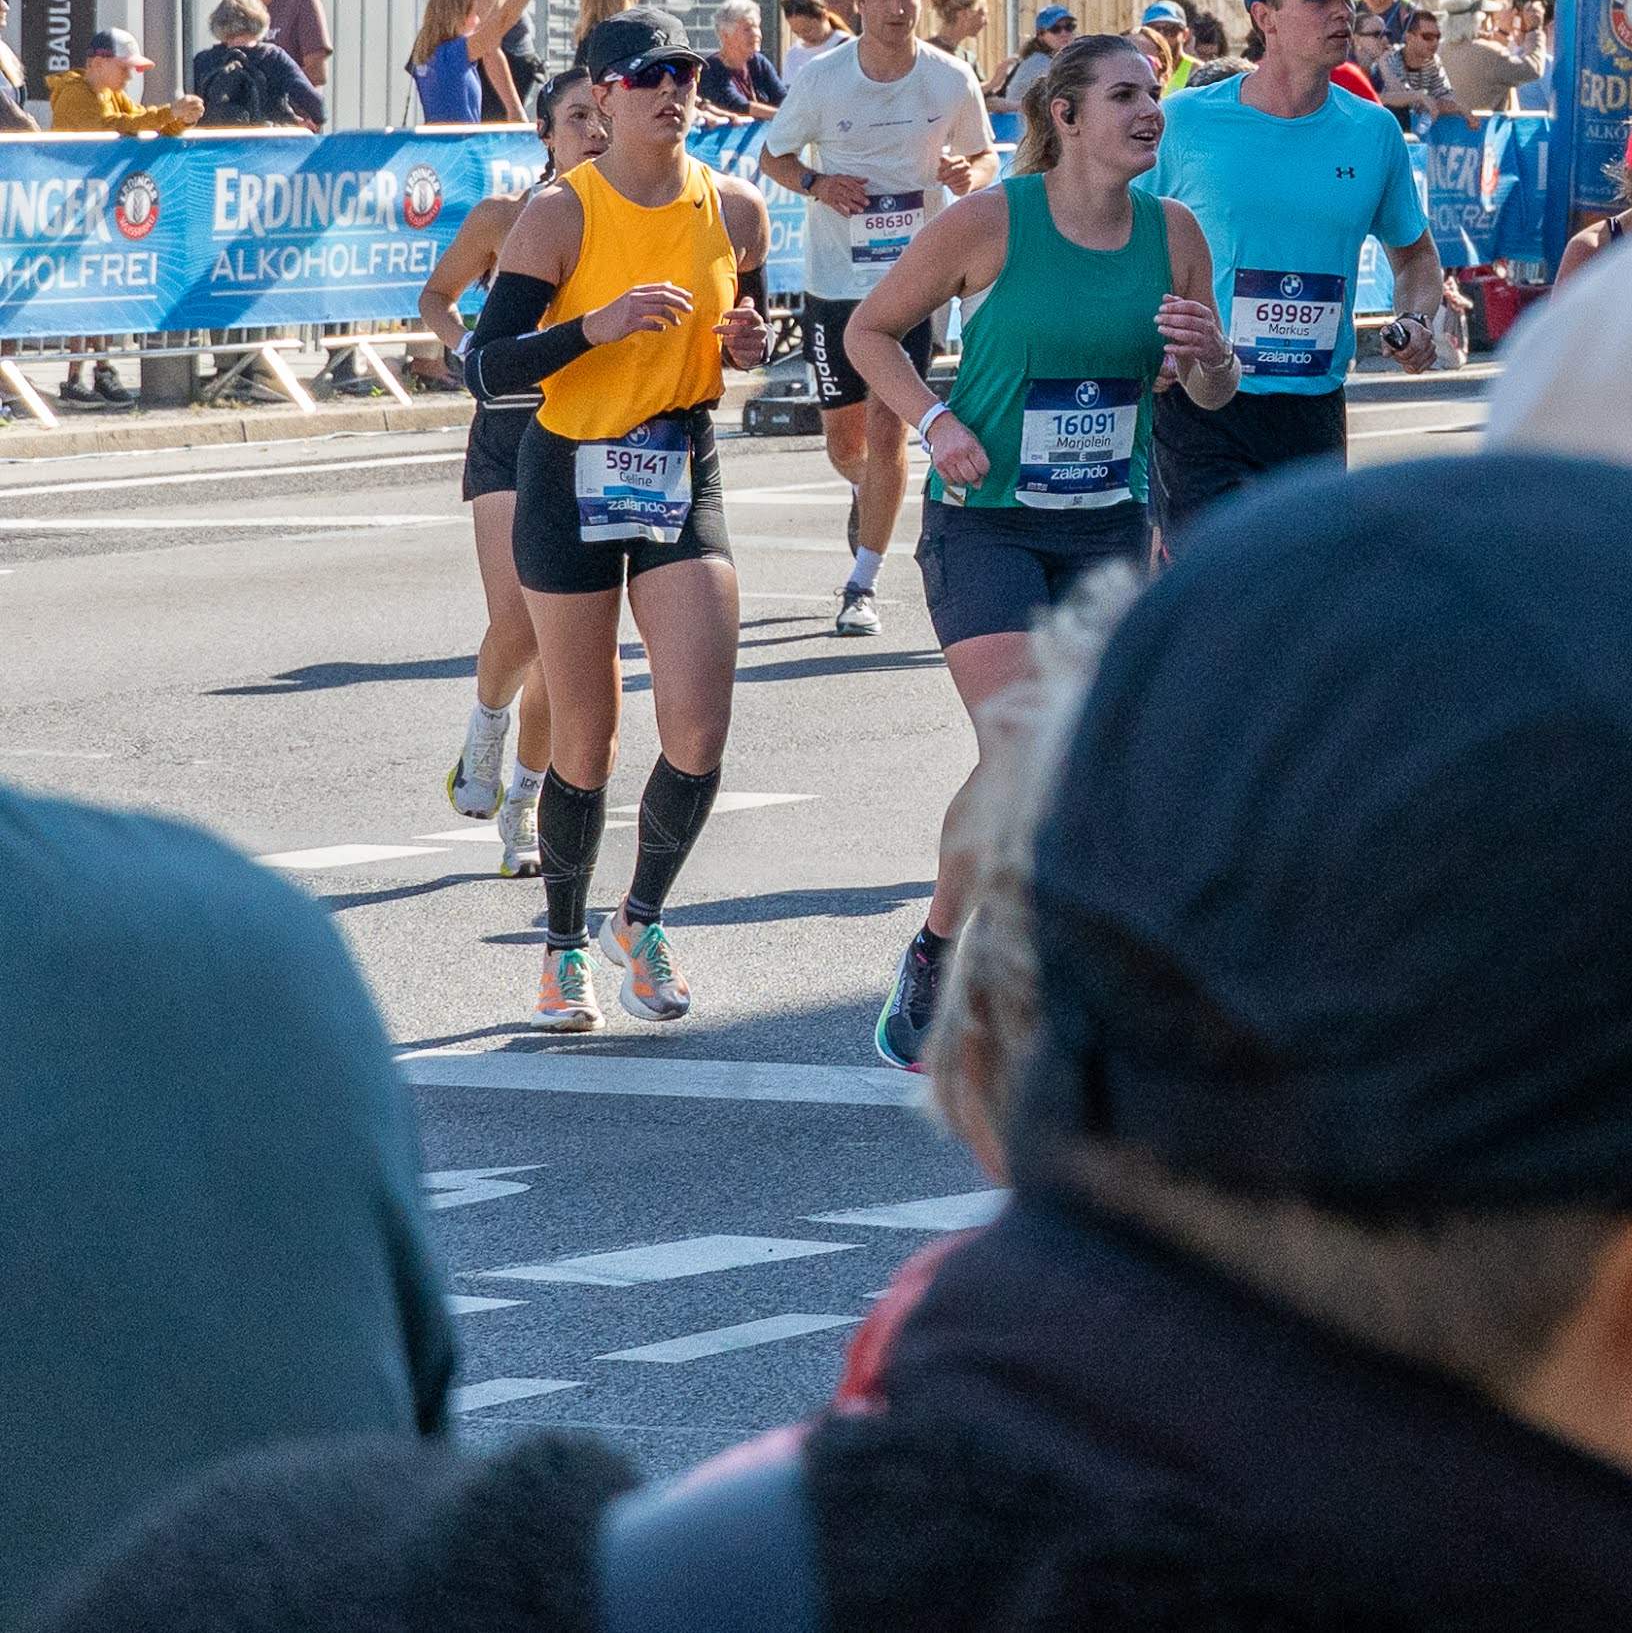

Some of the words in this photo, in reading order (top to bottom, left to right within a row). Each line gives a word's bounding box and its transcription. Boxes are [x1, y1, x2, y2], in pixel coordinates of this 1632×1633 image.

[213, 168, 398, 238] ERDINGER
[865, 212, 913, 230] 68630
[211, 240, 438, 283] ALKOHOLFREI
[1256, 303, 1325, 324] 69987
[1268, 323, 1310, 336] Markus
[812, 323, 842, 402] rappid.
[1257, 350, 1312, 364] zalando
[1053, 412, 1116, 436] 16091
[1056, 436, 1112, 451] Marjolein
[606, 449, 668, 475] 59141
[619, 471, 653, 487] Celine
[1050, 464, 1109, 481] zalando
[607, 498, 667, 514] zalando
